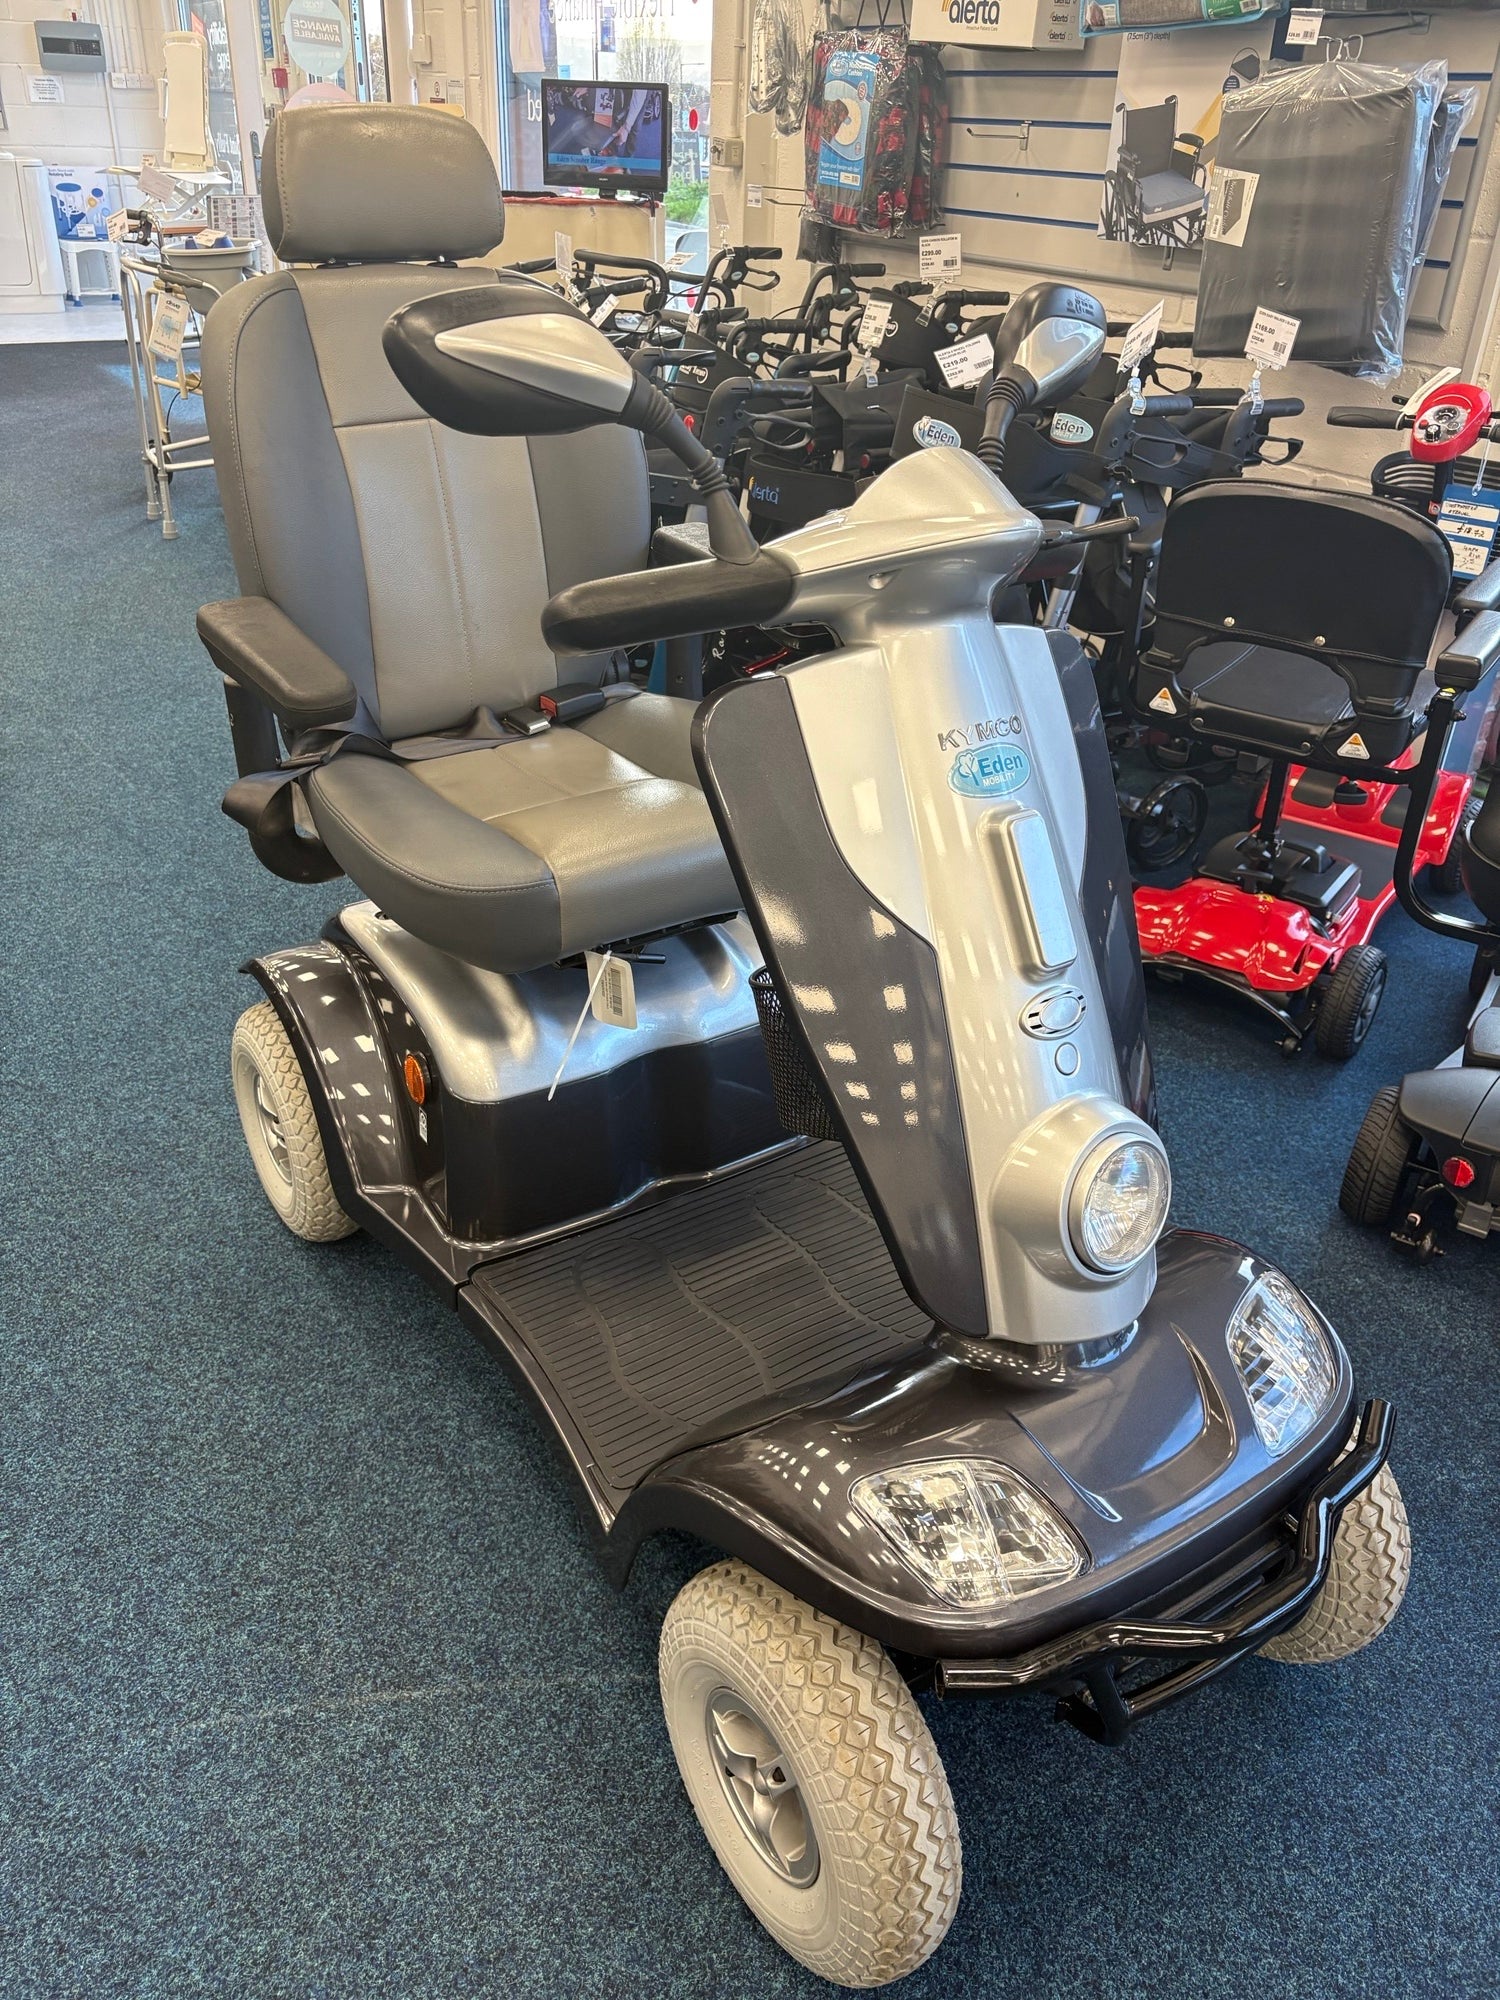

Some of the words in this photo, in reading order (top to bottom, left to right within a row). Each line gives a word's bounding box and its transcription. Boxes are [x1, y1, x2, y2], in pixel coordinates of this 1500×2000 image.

[949, 0, 1000, 25] alerta
[943, 356, 969, 368] £219.00
[927, 425, 955, 445] Eden
[1055, 418, 1084, 435] Eden
[752, 483, 780, 505] lerta
[937, 714, 1022, 751] KYMCO
[978, 754, 1023, 778] Eden
[982, 771, 1016, 787] MOBILITY
